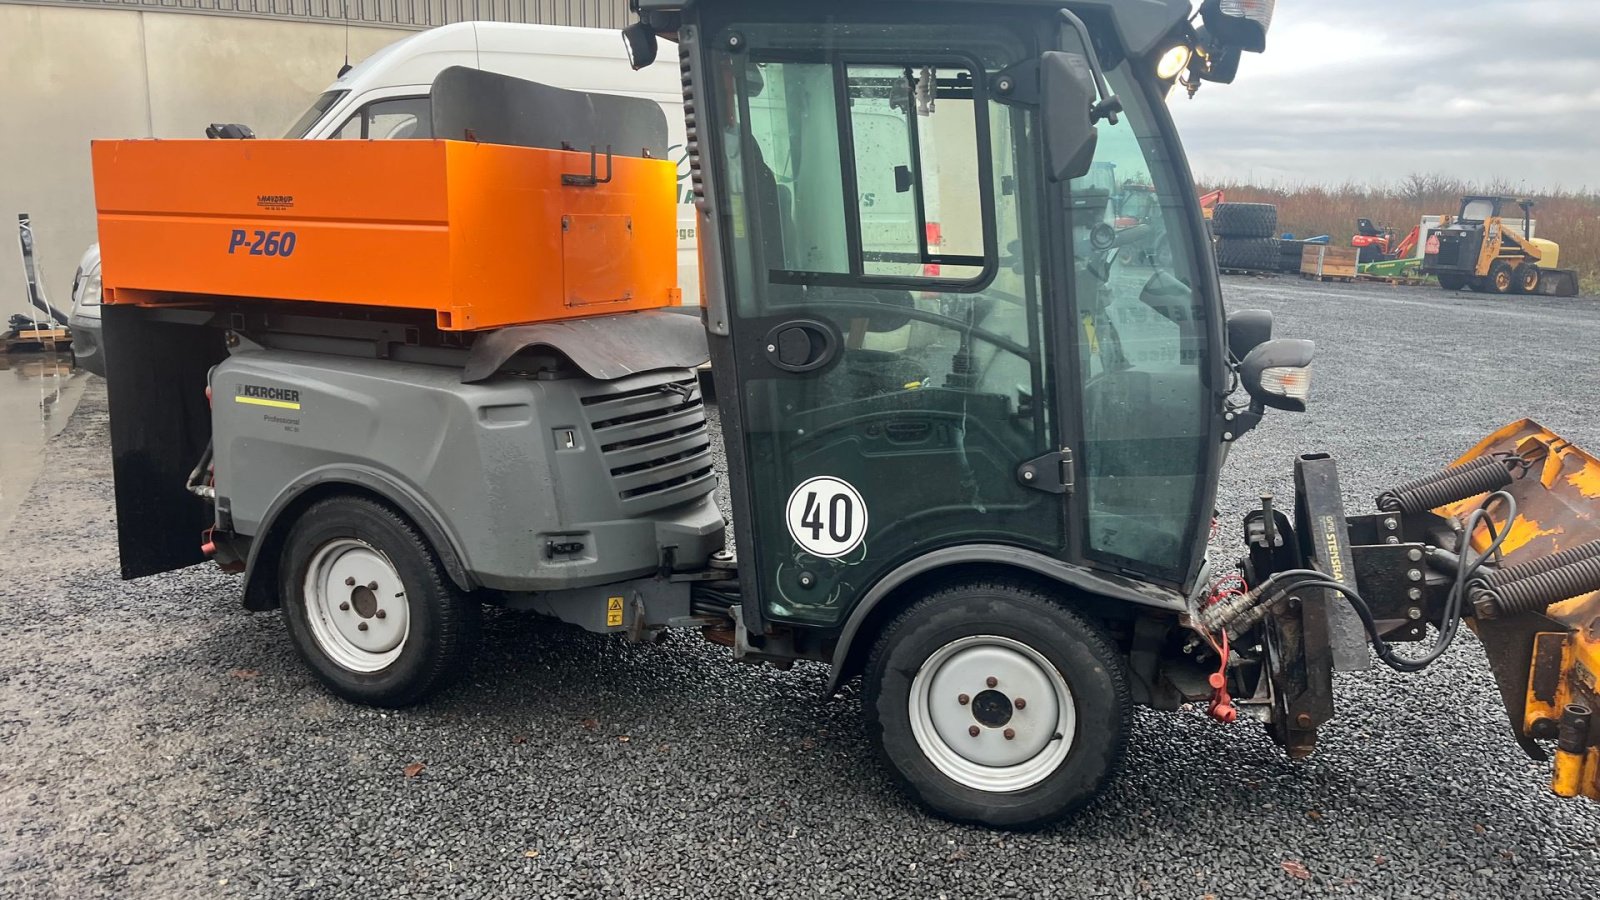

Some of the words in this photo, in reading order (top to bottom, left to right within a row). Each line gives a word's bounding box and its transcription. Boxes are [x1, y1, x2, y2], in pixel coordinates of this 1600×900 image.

[228, 229, 297, 257] P-260
[264, 414, 300, 425] Professional
[801, 491, 853, 543] 40
